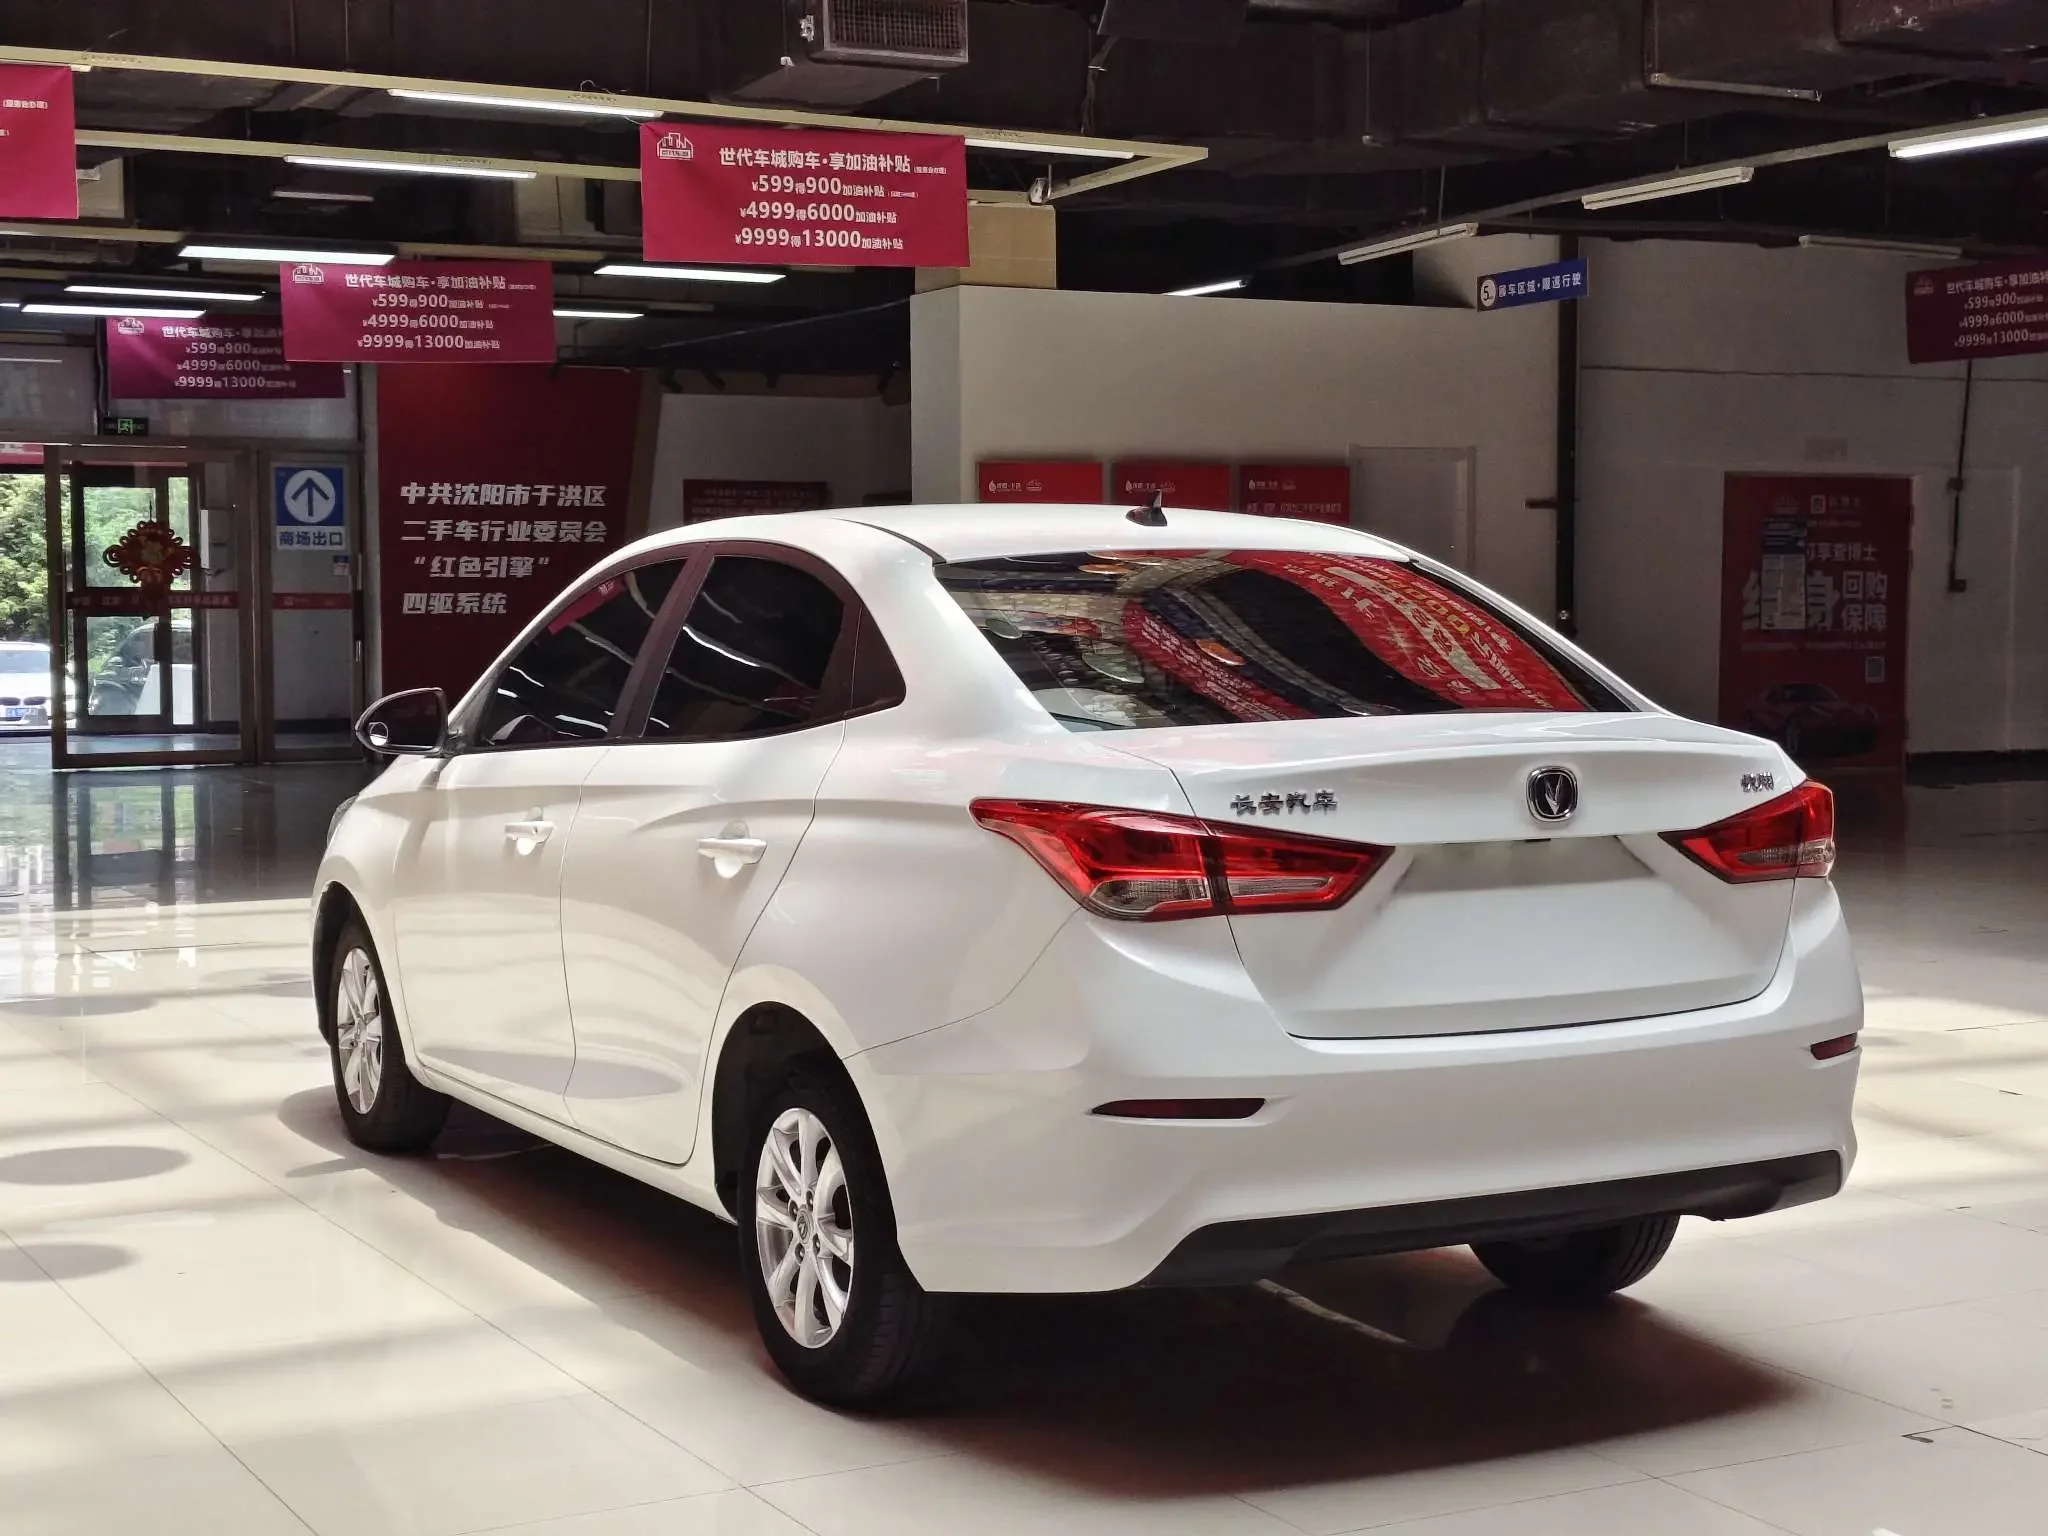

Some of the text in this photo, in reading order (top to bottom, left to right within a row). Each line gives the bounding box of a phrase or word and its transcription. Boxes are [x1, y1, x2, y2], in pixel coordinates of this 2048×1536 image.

[719, 147, 911, 173] 世代车城购车·享加油补贴
[400, 482, 608, 507] 中共沈阳市于洪区
[278, 530, 343, 547] 商场出口
[401, 520, 608, 543] 二手车行业委员会
[1842, 570, 1888, 600] 回购
[402, 592, 508, 615] 四驱系统
[1841, 603, 1888, 632] 保障
[1230, 788, 1339, 816] 长安汽车
